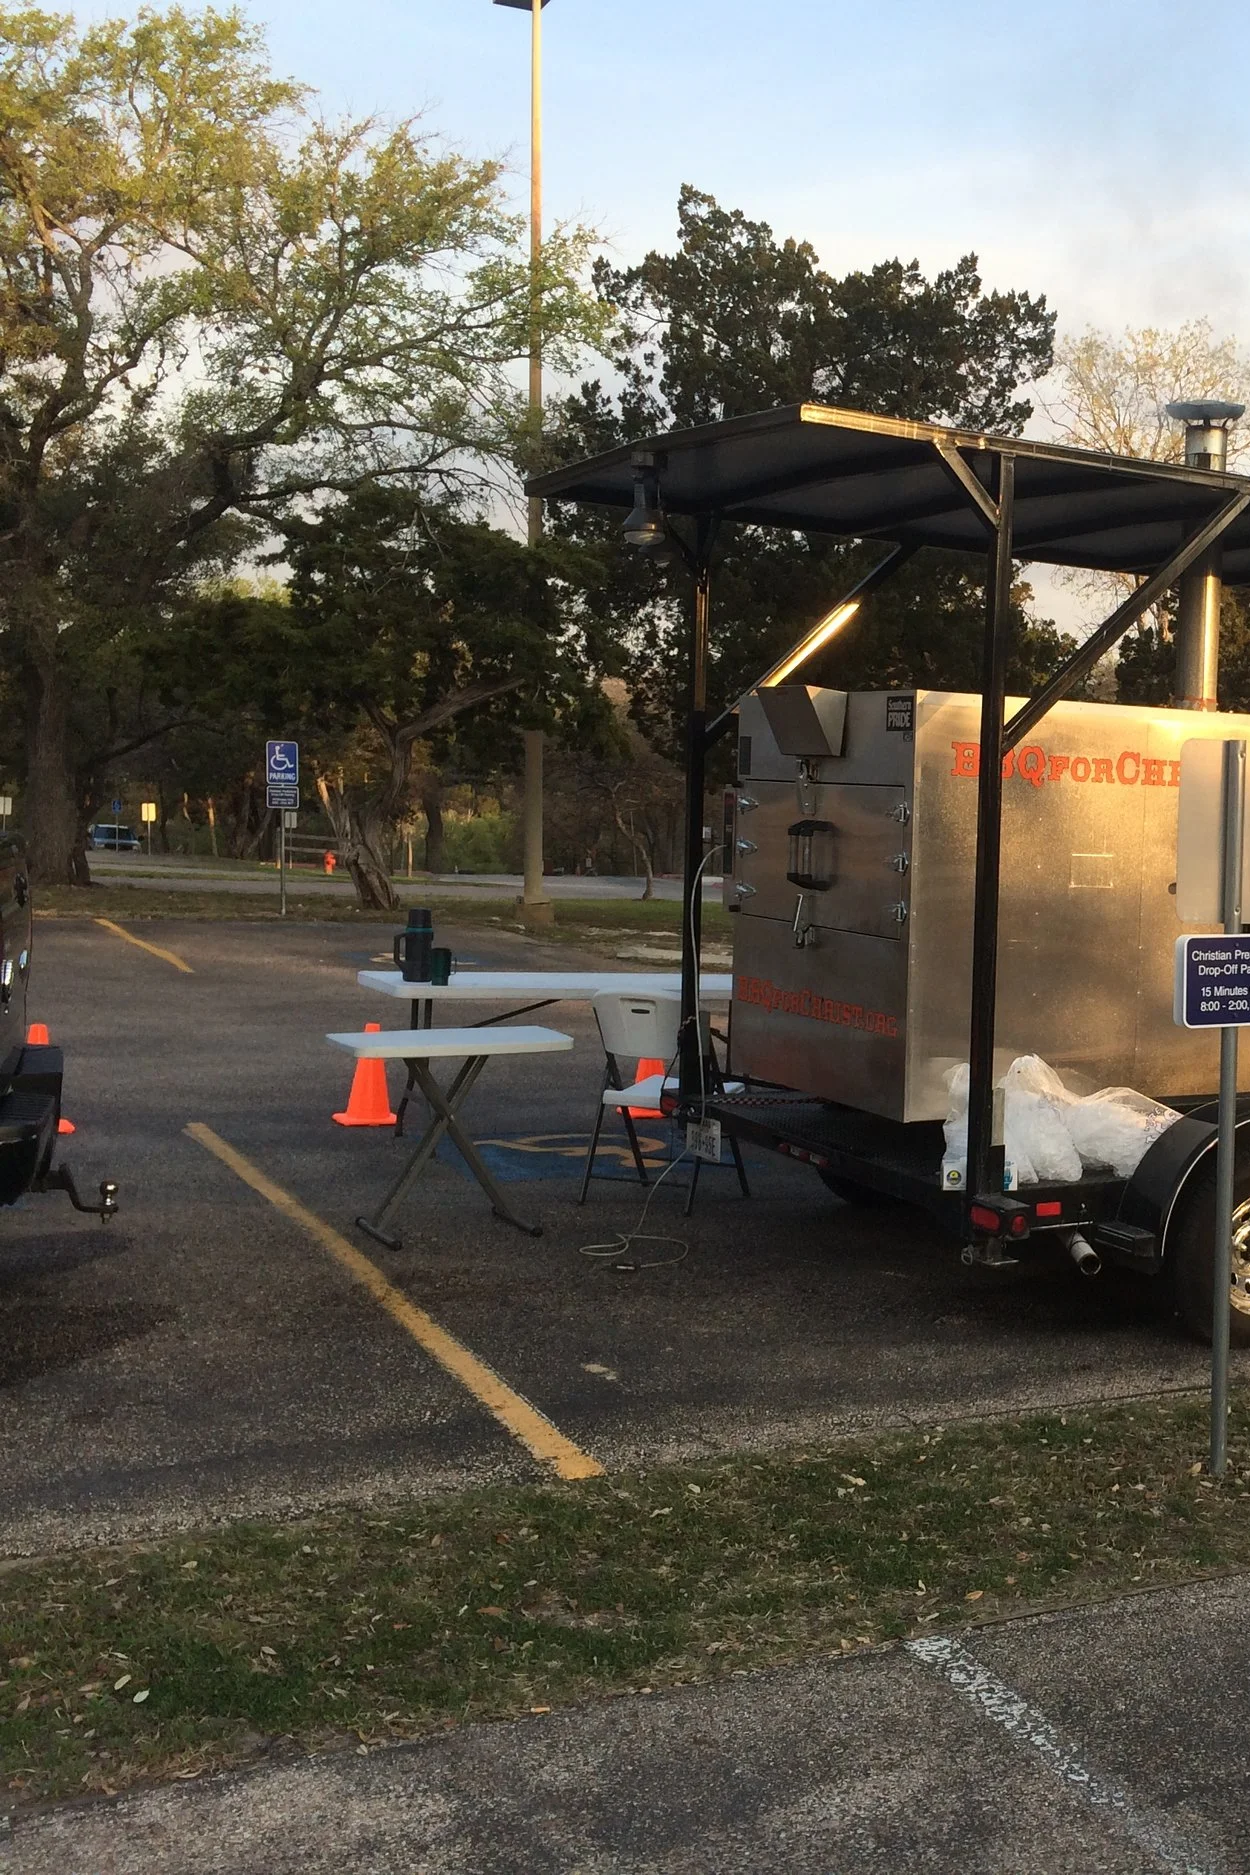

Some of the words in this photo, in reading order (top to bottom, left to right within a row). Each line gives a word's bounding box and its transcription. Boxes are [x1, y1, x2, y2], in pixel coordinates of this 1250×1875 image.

[888, 712, 911, 728] PRIDE
[269, 772, 296, 781] PARKING
[1191, 950, 1232, 961] Christian
[1198, 964, 1238, 977] Drop-Off
[1201, 986, 1212, 997] 15
[1213, 986, 1248, 997] Minutes
[1200, 1001, 1220, 1011] 8:00
[1228, 1000, 1250, 1011] 2:00,
